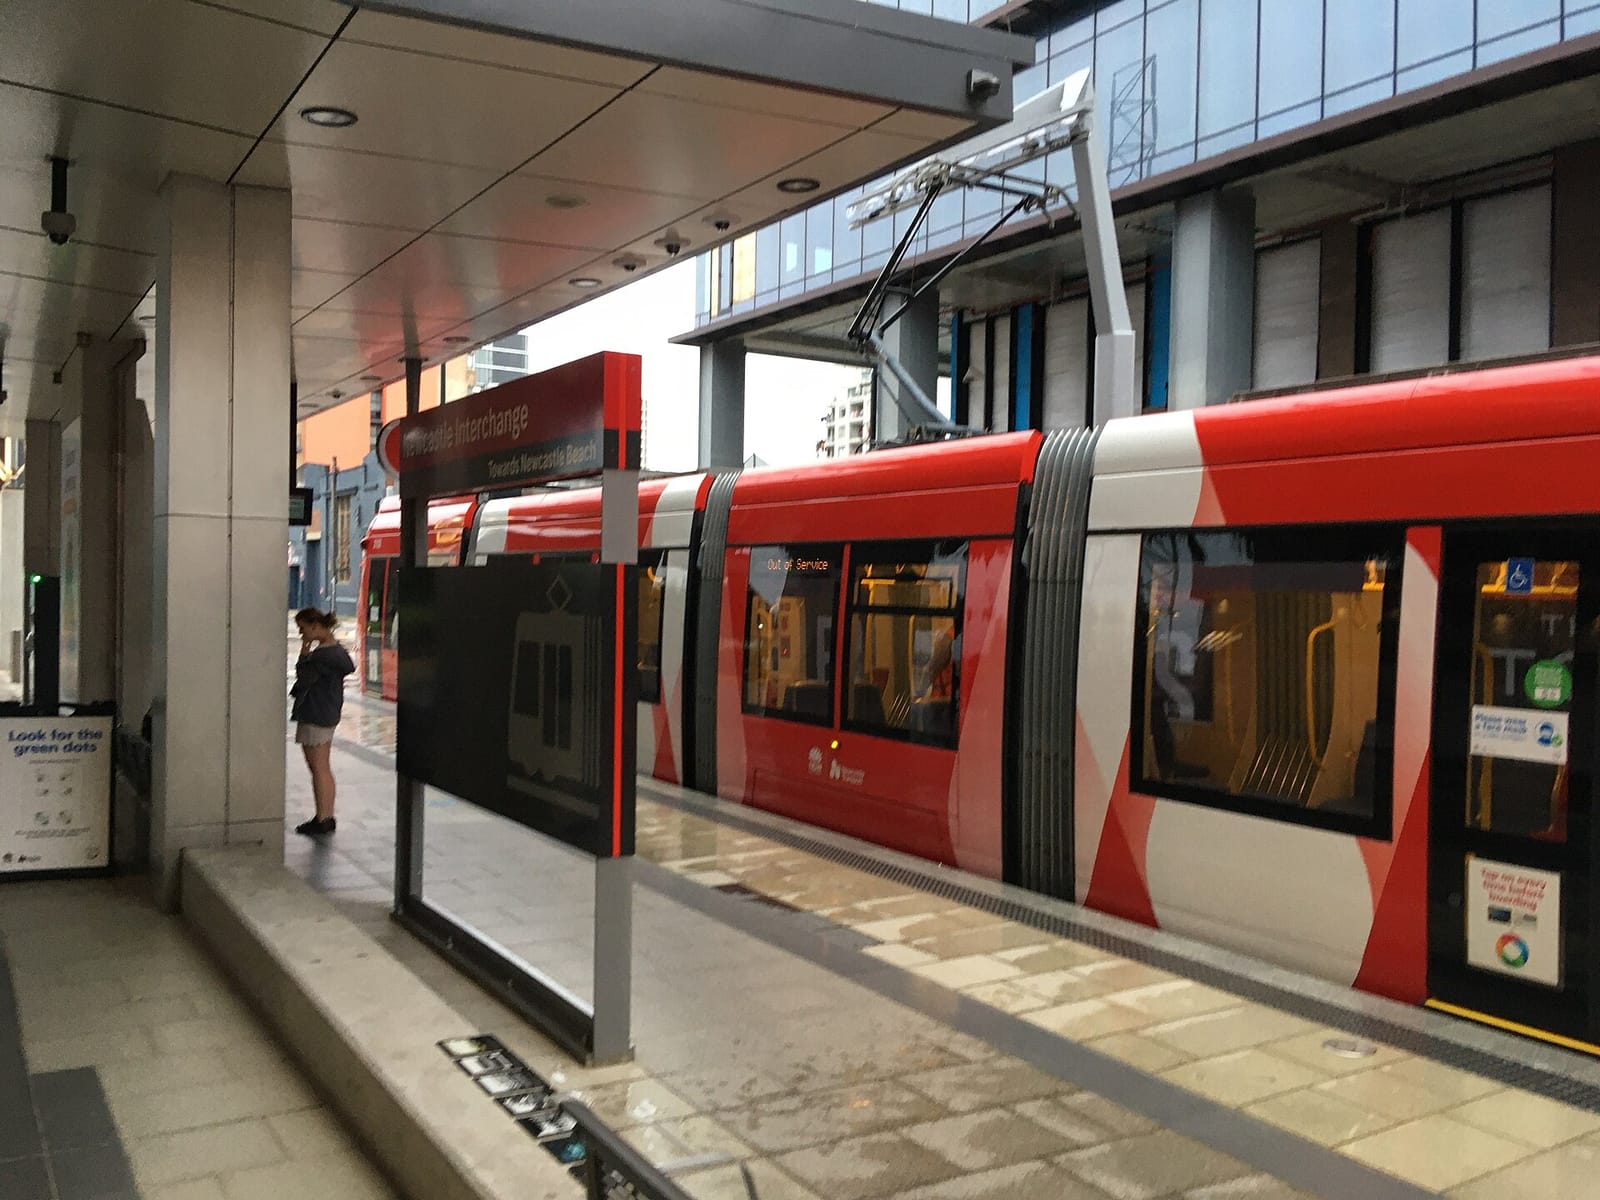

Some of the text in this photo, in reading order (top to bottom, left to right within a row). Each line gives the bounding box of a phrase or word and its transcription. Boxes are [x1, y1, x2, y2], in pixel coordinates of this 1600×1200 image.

[455, 402, 529, 446] Interchange
[488, 440, 598, 479] Towards Newcastle Beach
[767, 557, 829, 571] Out of Service
[8, 728, 103, 742] Look for the
[13, 741, 98, 757] green dots
